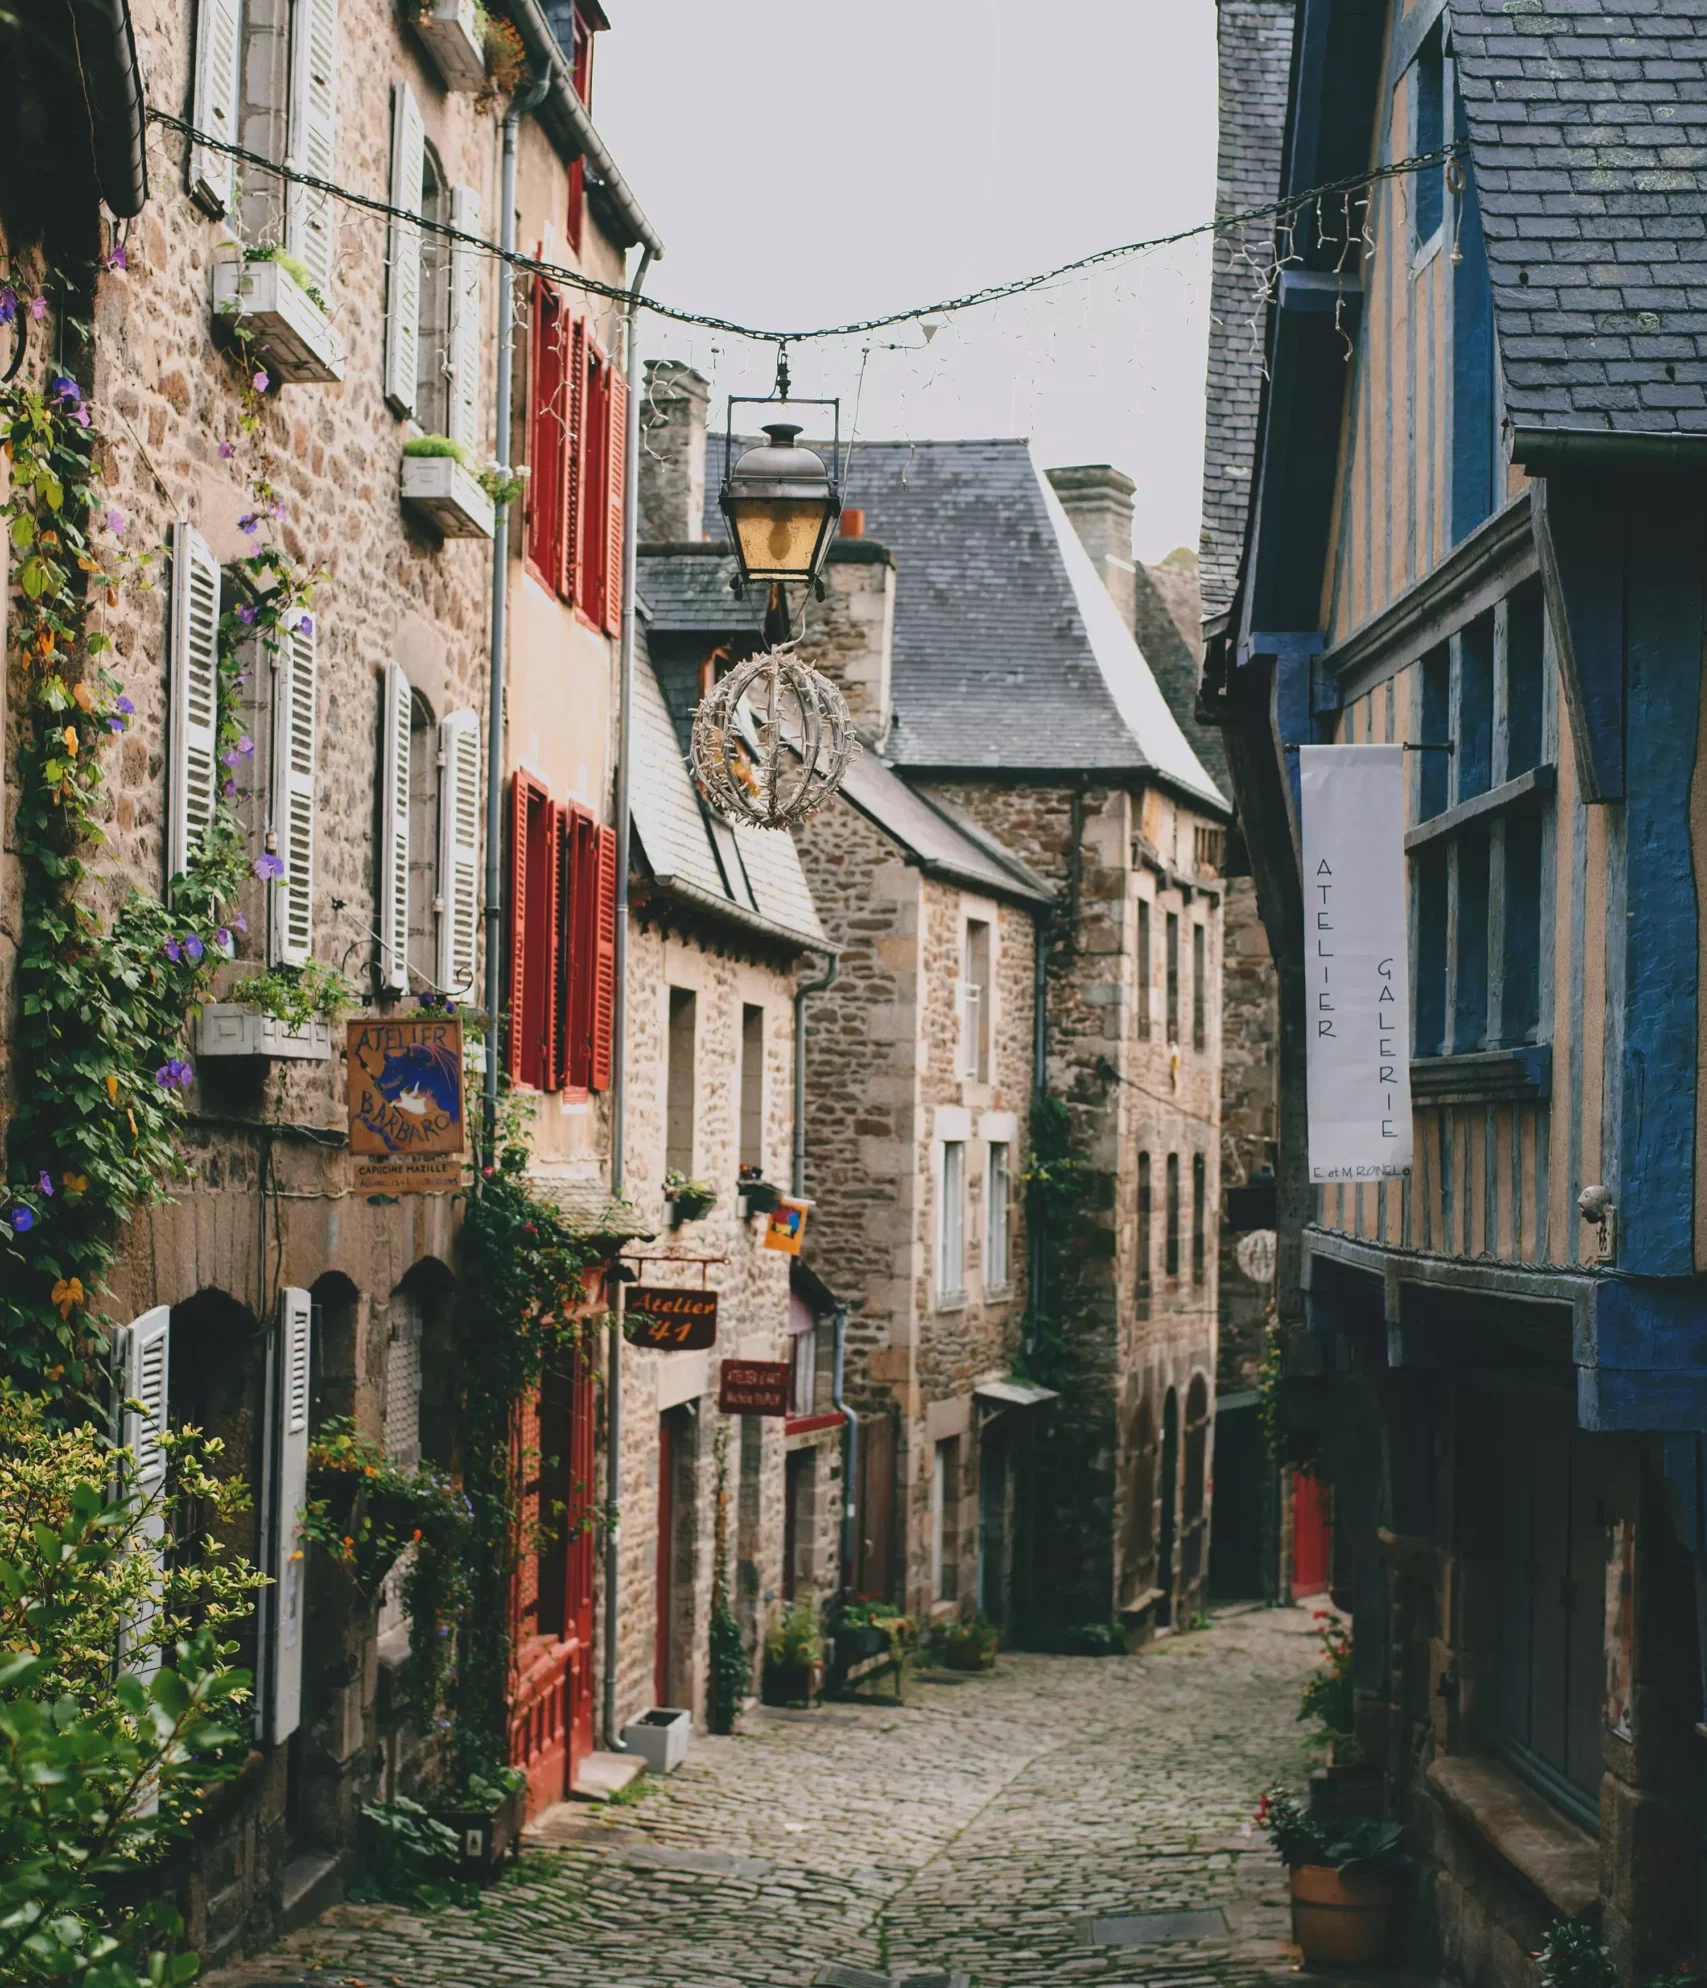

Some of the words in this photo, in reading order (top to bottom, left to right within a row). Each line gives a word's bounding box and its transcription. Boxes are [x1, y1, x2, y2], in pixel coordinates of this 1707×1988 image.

[1316, 858, 1337, 1038] ATELIER
[356, 1026, 447, 1054] ATELIER
[1377, 957, 1398, 1138] GALERIE
[361, 1091, 450, 1143] BARBARO
[1328, 1166, 1340, 1178] et
[632, 1292, 716, 1314] Atelier
[647, 1319, 692, 1342] 41
